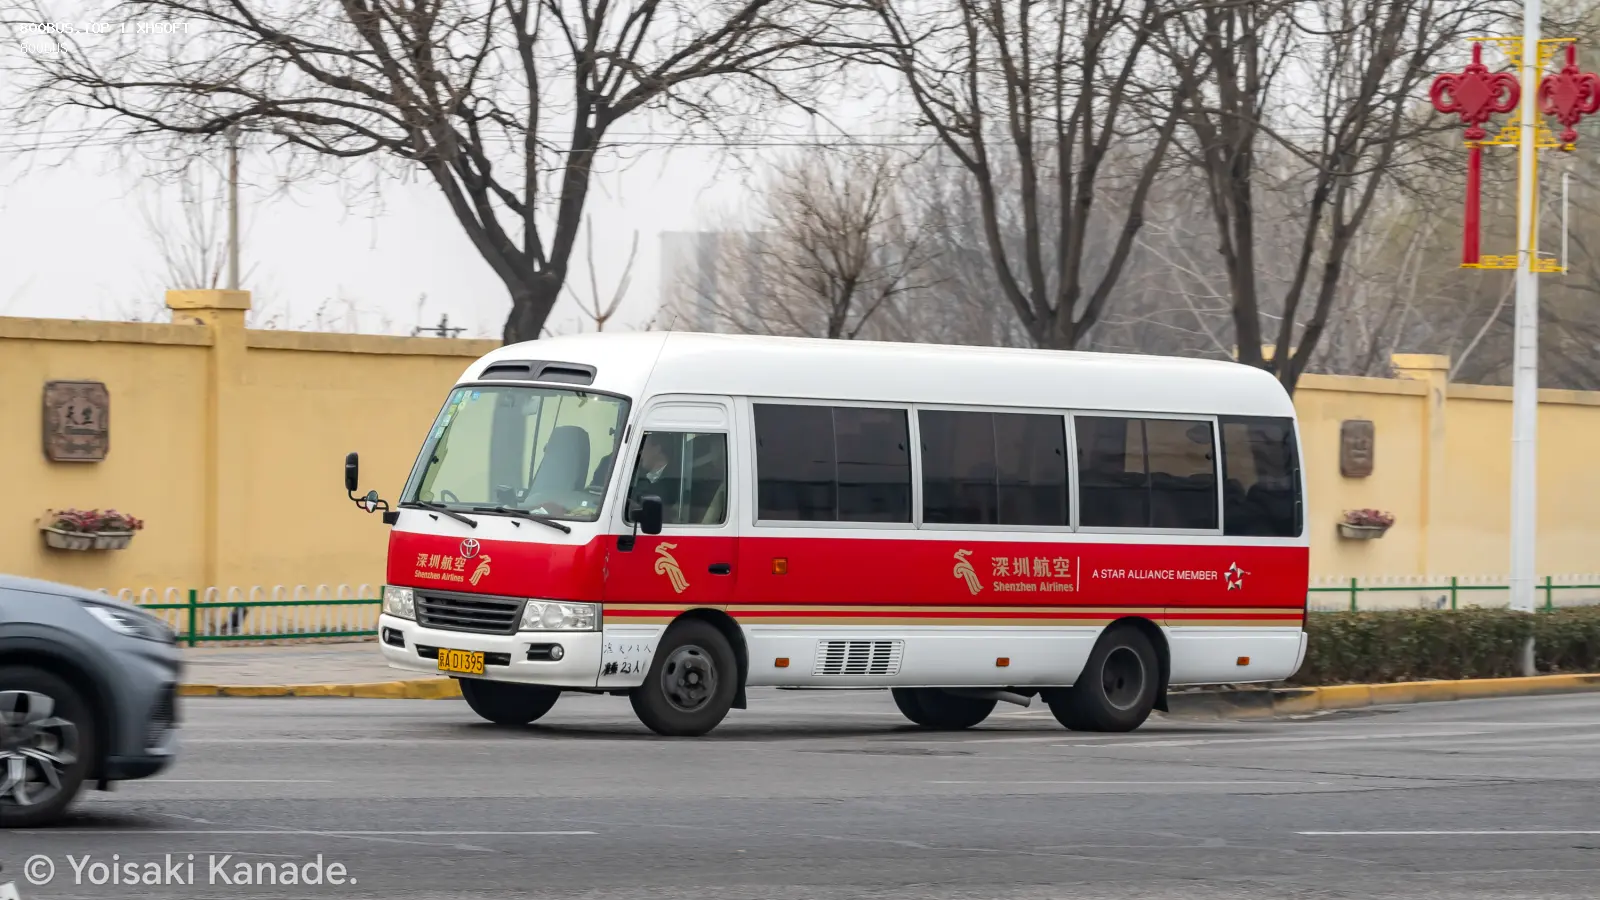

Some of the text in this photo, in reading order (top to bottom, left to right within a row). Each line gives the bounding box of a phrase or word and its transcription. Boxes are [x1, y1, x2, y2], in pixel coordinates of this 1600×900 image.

[416, 553, 467, 572] 深圳航空
[991, 556, 1071, 578] 深圳航空
[414, 569, 464, 583] Shenzhen Airlines
[1092, 569, 1218, 581] A STAR ALLIANCE MEMBER
[993, 581, 1074, 592] Shenzhen Airlines
